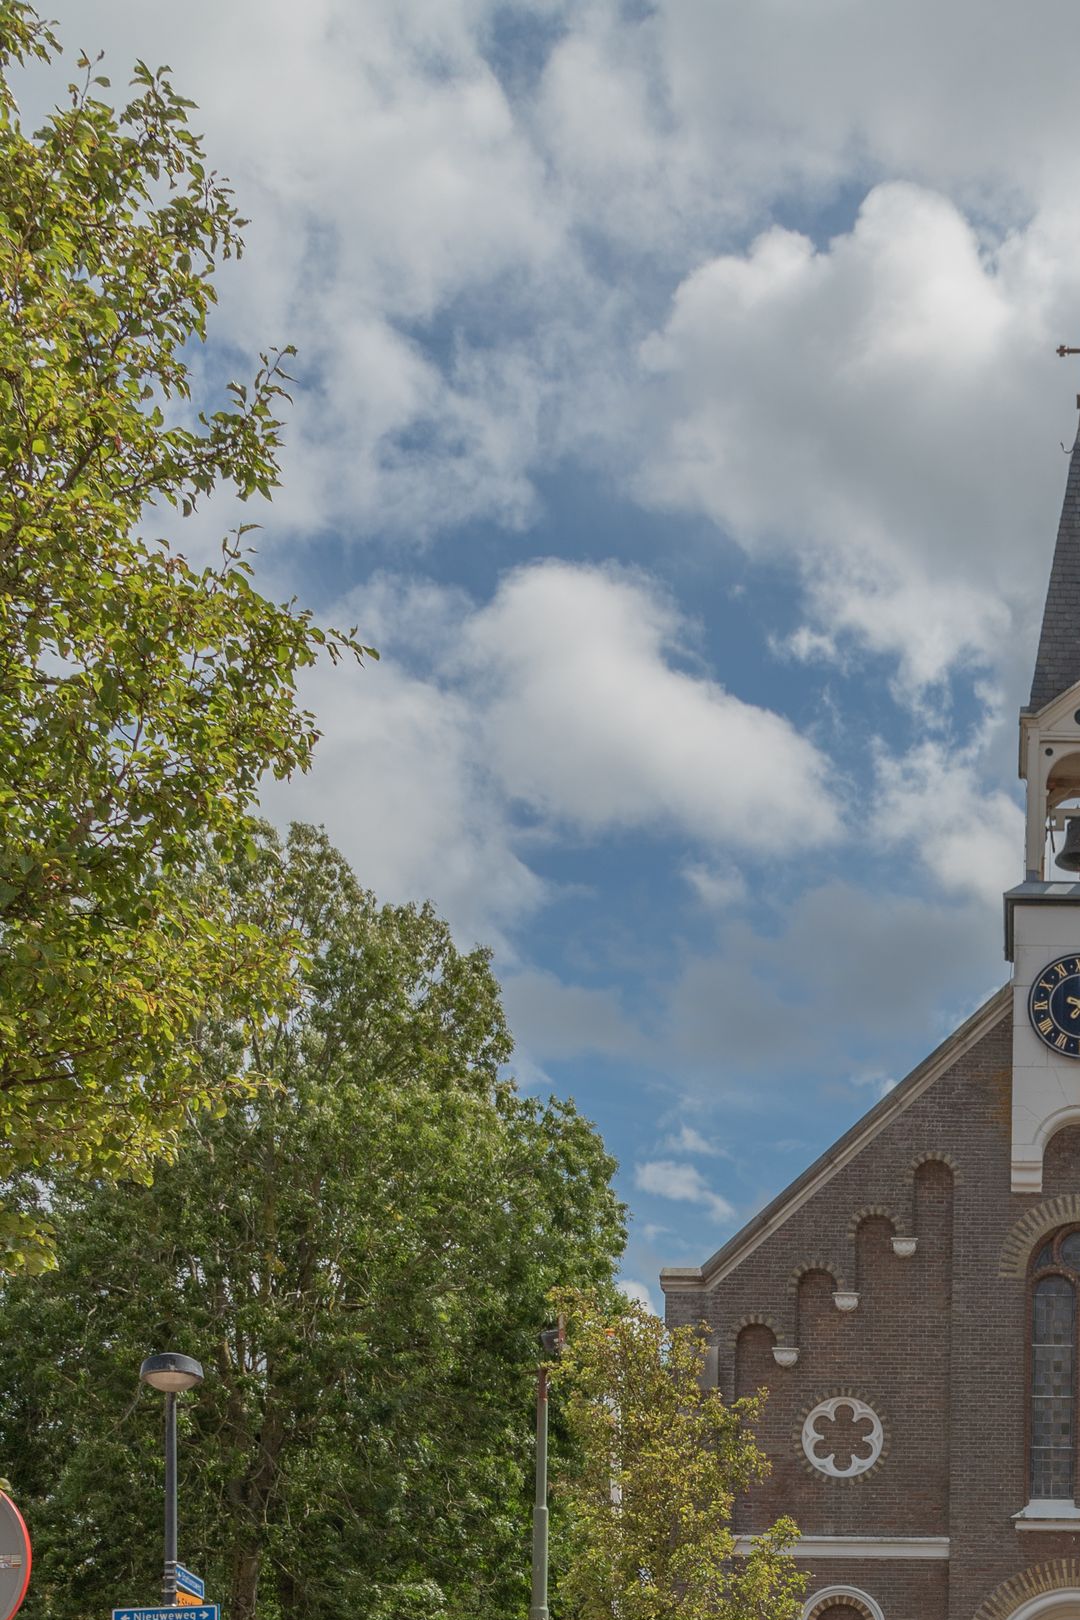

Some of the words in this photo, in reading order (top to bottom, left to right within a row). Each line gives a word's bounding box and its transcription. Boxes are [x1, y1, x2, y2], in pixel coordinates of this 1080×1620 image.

[1054, 963, 1068, 978] XI
[1039, 980, 1053, 991] X
[1034, 1000, 1048, 1010] IX
[1038, 1018, 1054, 1035] VIII
[1055, 1033, 1068, 1049] VII
